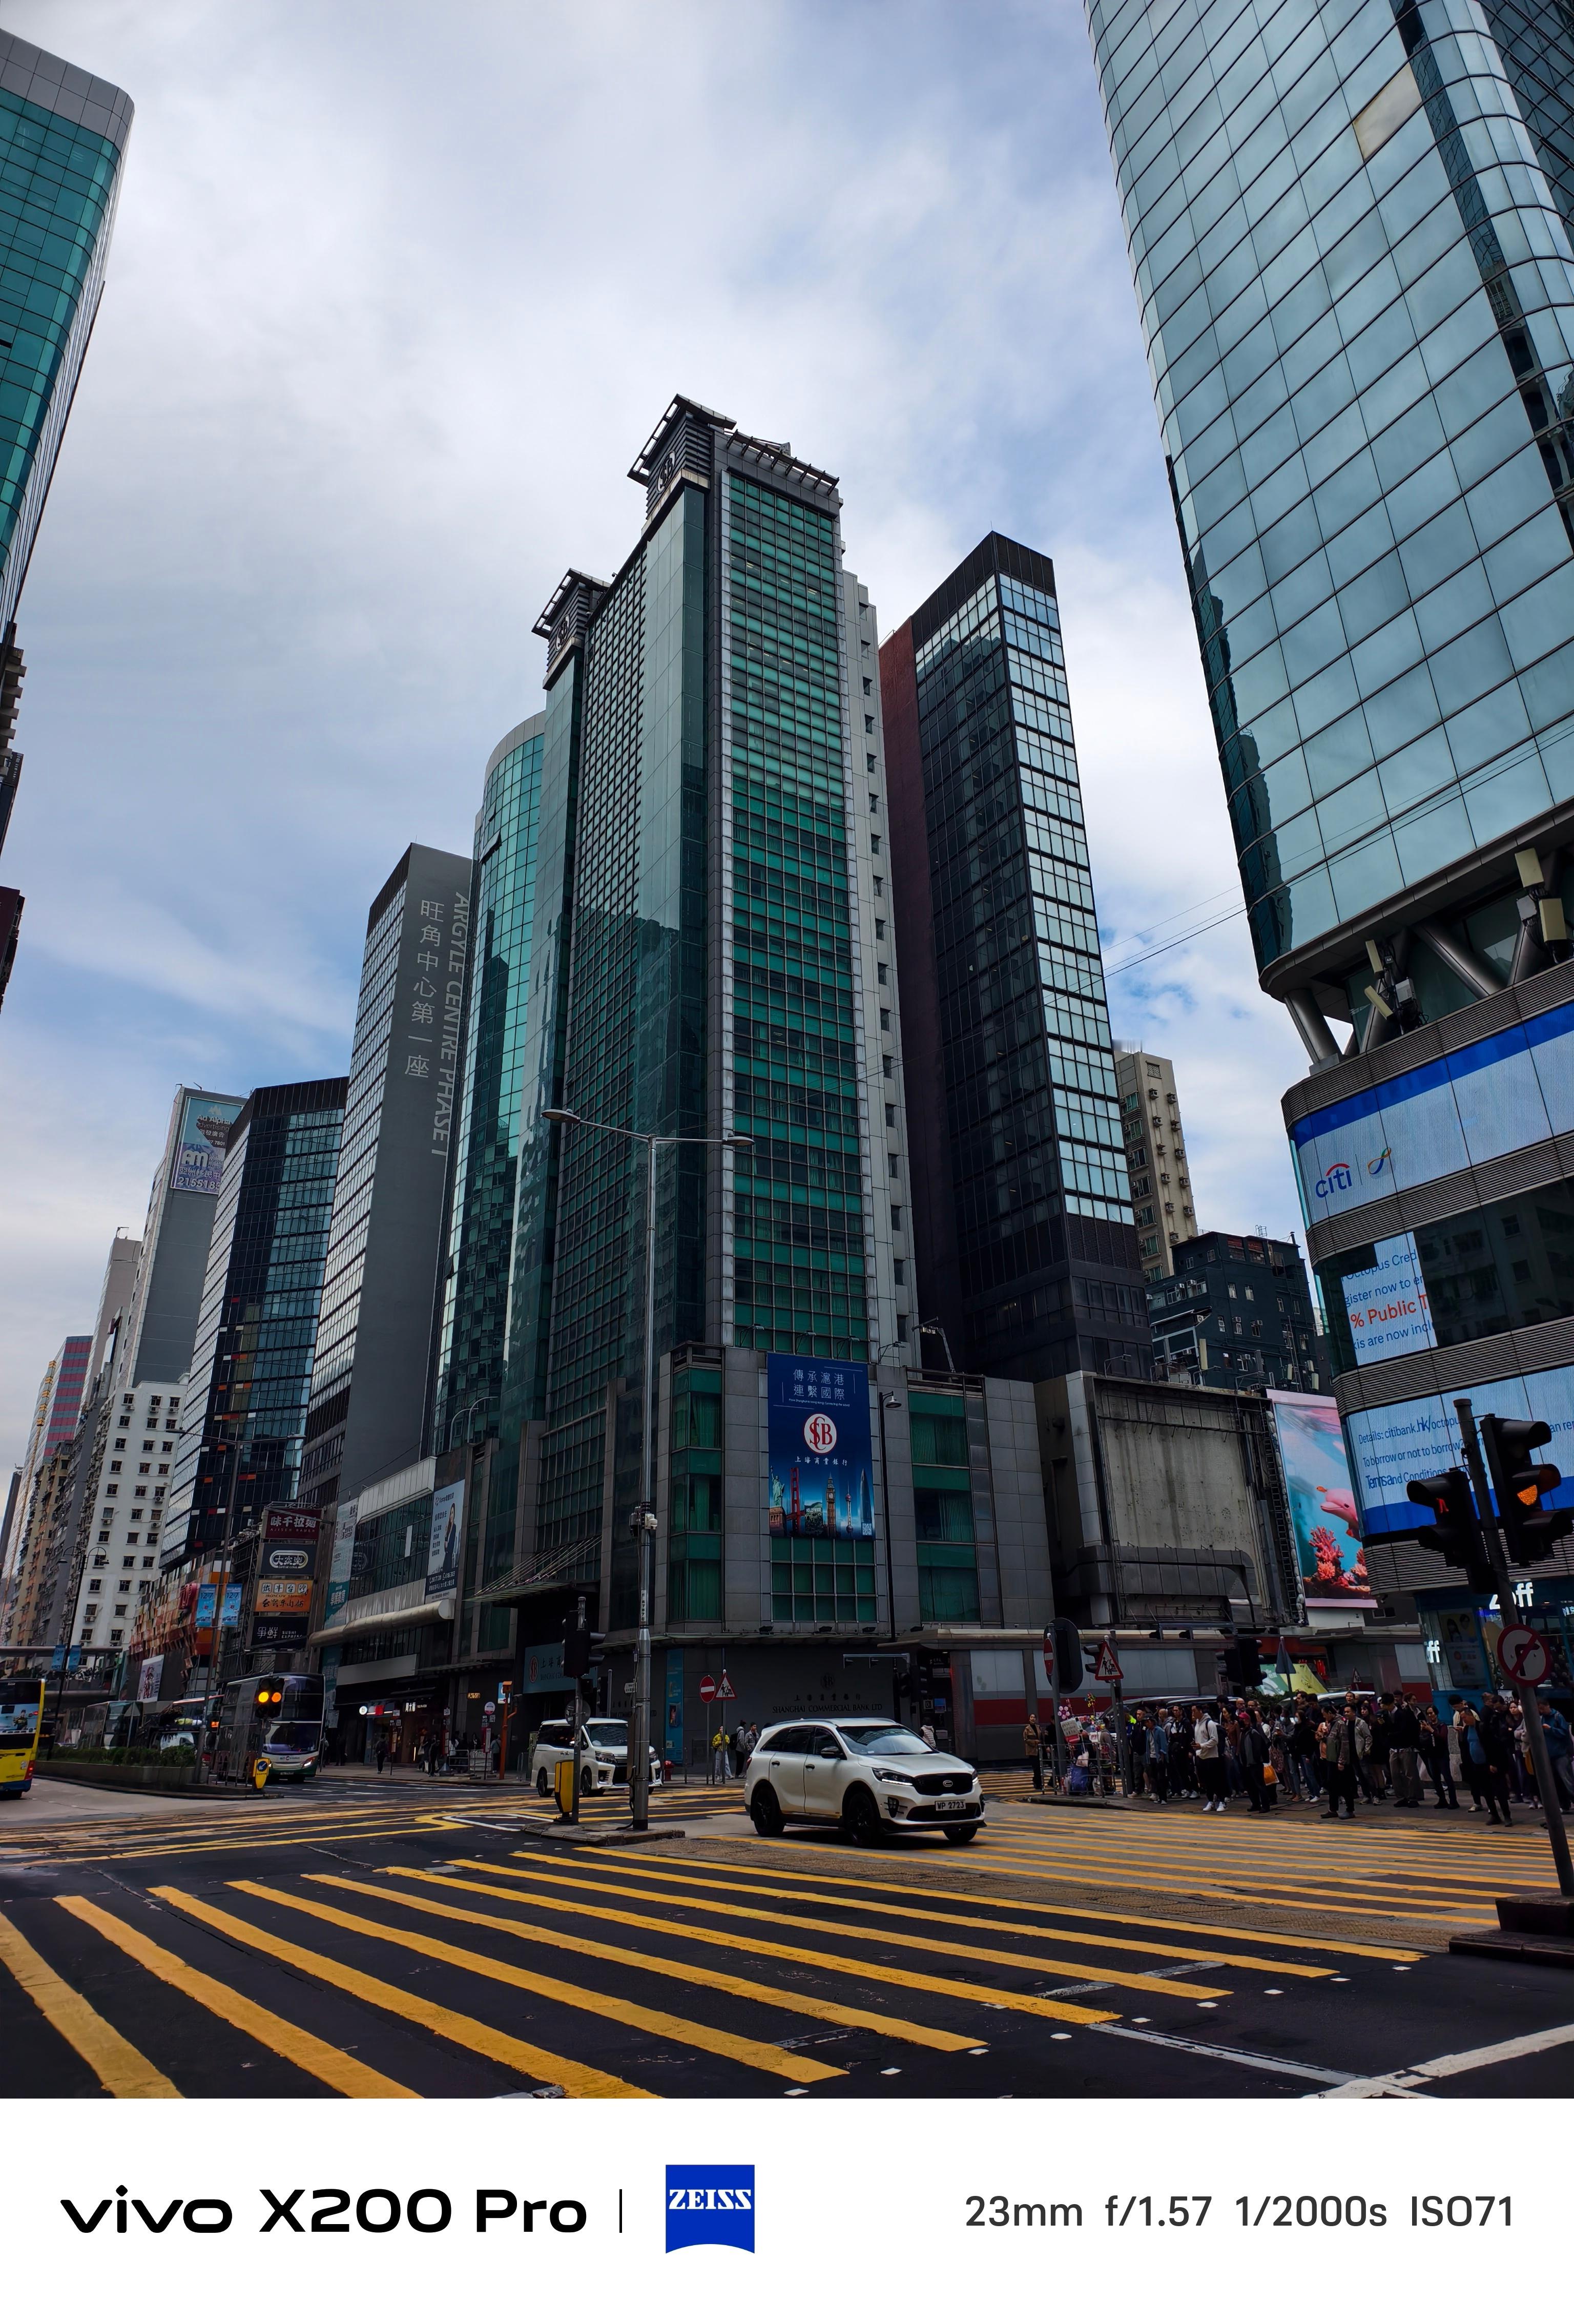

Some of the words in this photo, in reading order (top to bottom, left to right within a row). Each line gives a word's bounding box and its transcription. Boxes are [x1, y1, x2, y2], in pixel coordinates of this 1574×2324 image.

[448, 891, 470, 973] ARGYLE
[405, 900, 445, 1078] 旺角中心第一座
[441, 981, 462, 1060] CENTRE
[433, 1068, 455, 1140] PHASE
[196, 1122, 230, 1132] advertising
[210, 1115, 230, 1125] Alpha
[1316, 1169, 1352, 1198] citi
[1392, 1249, 1417, 1266] Cred
[1375, 1283, 1397, 1297] now
[1399, 1279, 1411, 1289] to
[1368, 1300, 1417, 1324] Public
[1368, 1335, 1384, 1346] are
[1386, 1329, 1409, 1341] now
[793, 1369, 844, 1385] 傳承滬港
[793, 1384, 845, 1400] 連繫國際
[1359, 1430, 1383, 1444] Details:
[795, 1456, 848, 1466] 上海商業銀行
[1362, 1457, 1370, 1467] To
[1370, 1454, 1396, 1466] borrow
[1398, 1452, 1406, 1460] or
[1407, 1449, 1420, 1460] not
[1422, 1447, 1431, 1456] to
[1431, 1439, 1464, 1455] borrow?
[1489, 1582, 1534, 1610] Zff
[948, 1801, 964, 1809] 2723
